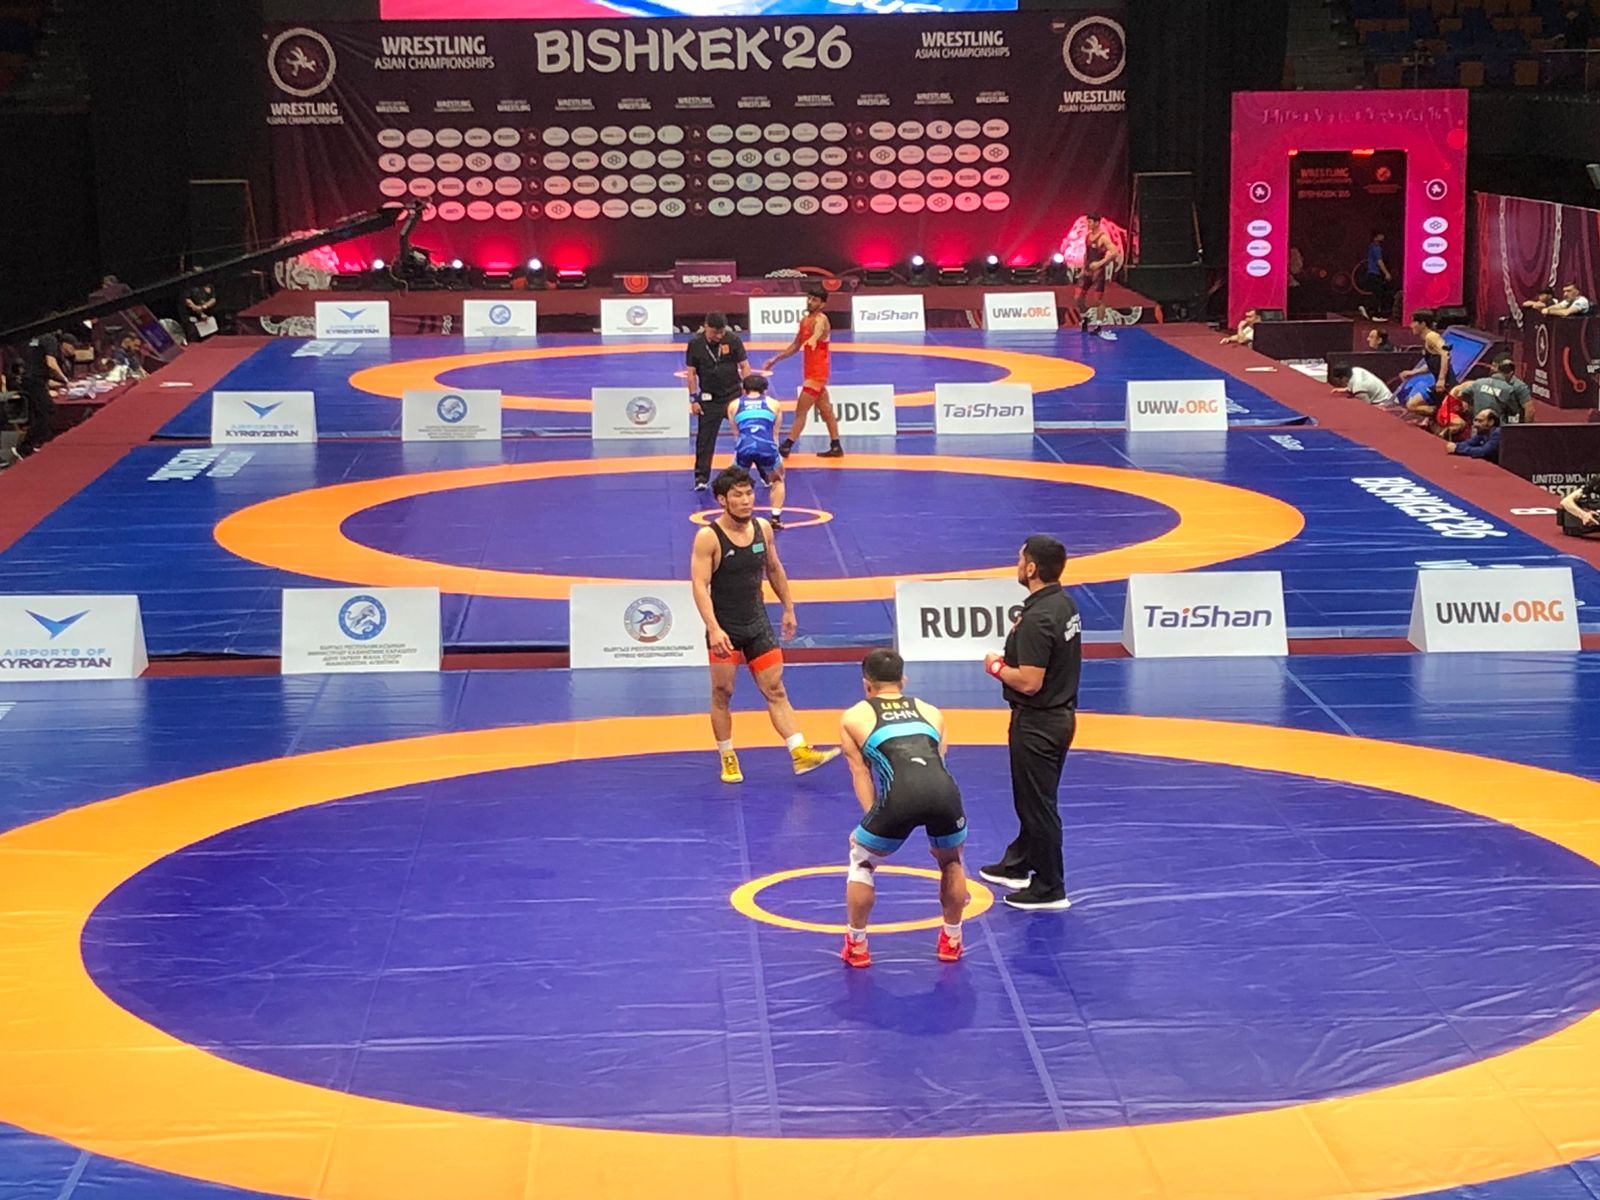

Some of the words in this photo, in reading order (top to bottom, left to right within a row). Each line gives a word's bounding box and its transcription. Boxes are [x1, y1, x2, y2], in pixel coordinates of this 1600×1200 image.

[921, 30, 1004, 47] WRESTLING
[381, 36, 486, 56] WRESTLING
[534, 25, 852, 73] BISHKEK'26
[915, 48, 940, 58] ASIAN
[942, 46, 1010, 58] CHAMPIONSHIPS
[374, 57, 406, 69] ASIAN
[408, 56, 495, 69] CHAMPIONSHIPS
[270, 102, 339, 115] WRESTLING
[860, 310, 919, 321] TaiShan
[993, 306, 1051, 318] UWW.ORG
[943, 403, 1024, 418] TaiShan
[1137, 400, 1218, 414] UWW.ORG
[1532, 474, 1564, 484] UNITED
[1143, 605, 1272, 629] TaiShan
[1436, 600, 1564, 624] UWW.ORG
[4, 648, 80, 656] AIRPORTS
[87, 648, 106, 656] OF
[881, 710, 919, 721] CHN
